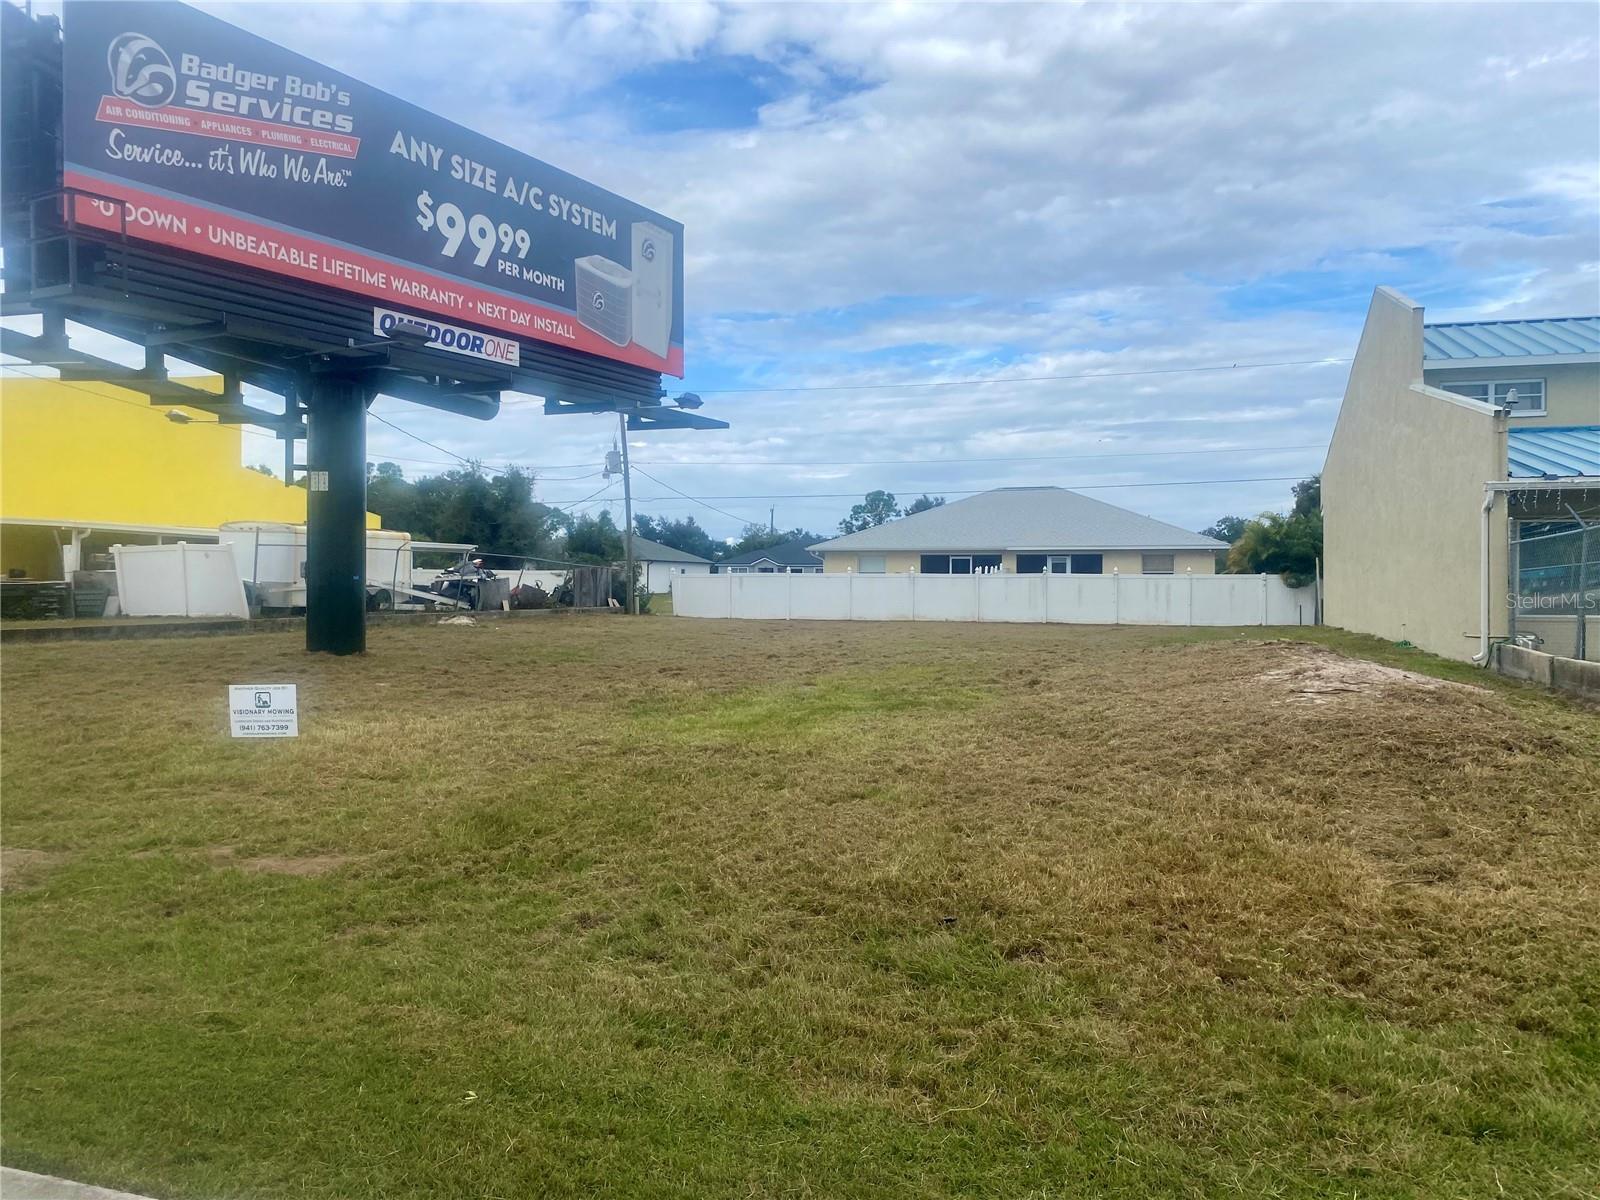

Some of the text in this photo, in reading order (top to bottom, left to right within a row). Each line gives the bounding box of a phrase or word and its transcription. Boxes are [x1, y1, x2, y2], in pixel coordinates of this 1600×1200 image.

[181, 53, 350, 106] Badger Bob's
[105, 105, 353, 152] AIR CONDITIONING APPLIANCES PLUMBING ELECTRICAL
[185, 80, 353, 133] Services
[208, 144, 234, 175] it's
[240, 147, 277, 178] Who
[284, 154, 311, 182] We
[390, 130, 617, 240] ANY SIZE A/C SYSTEM
[125, 202, 187, 235] DOWN
[208, 225, 318, 270] UNBEATABLE
[322, 256, 387, 289] LIFETIME
[391, 275, 464, 309] WARRANTY
[477, 299, 508, 320] NEXT
[510, 311, 531, 325] DAY
[534, 315, 576, 339] INSTALL
[498, 259, 565, 292] PER MONTH
